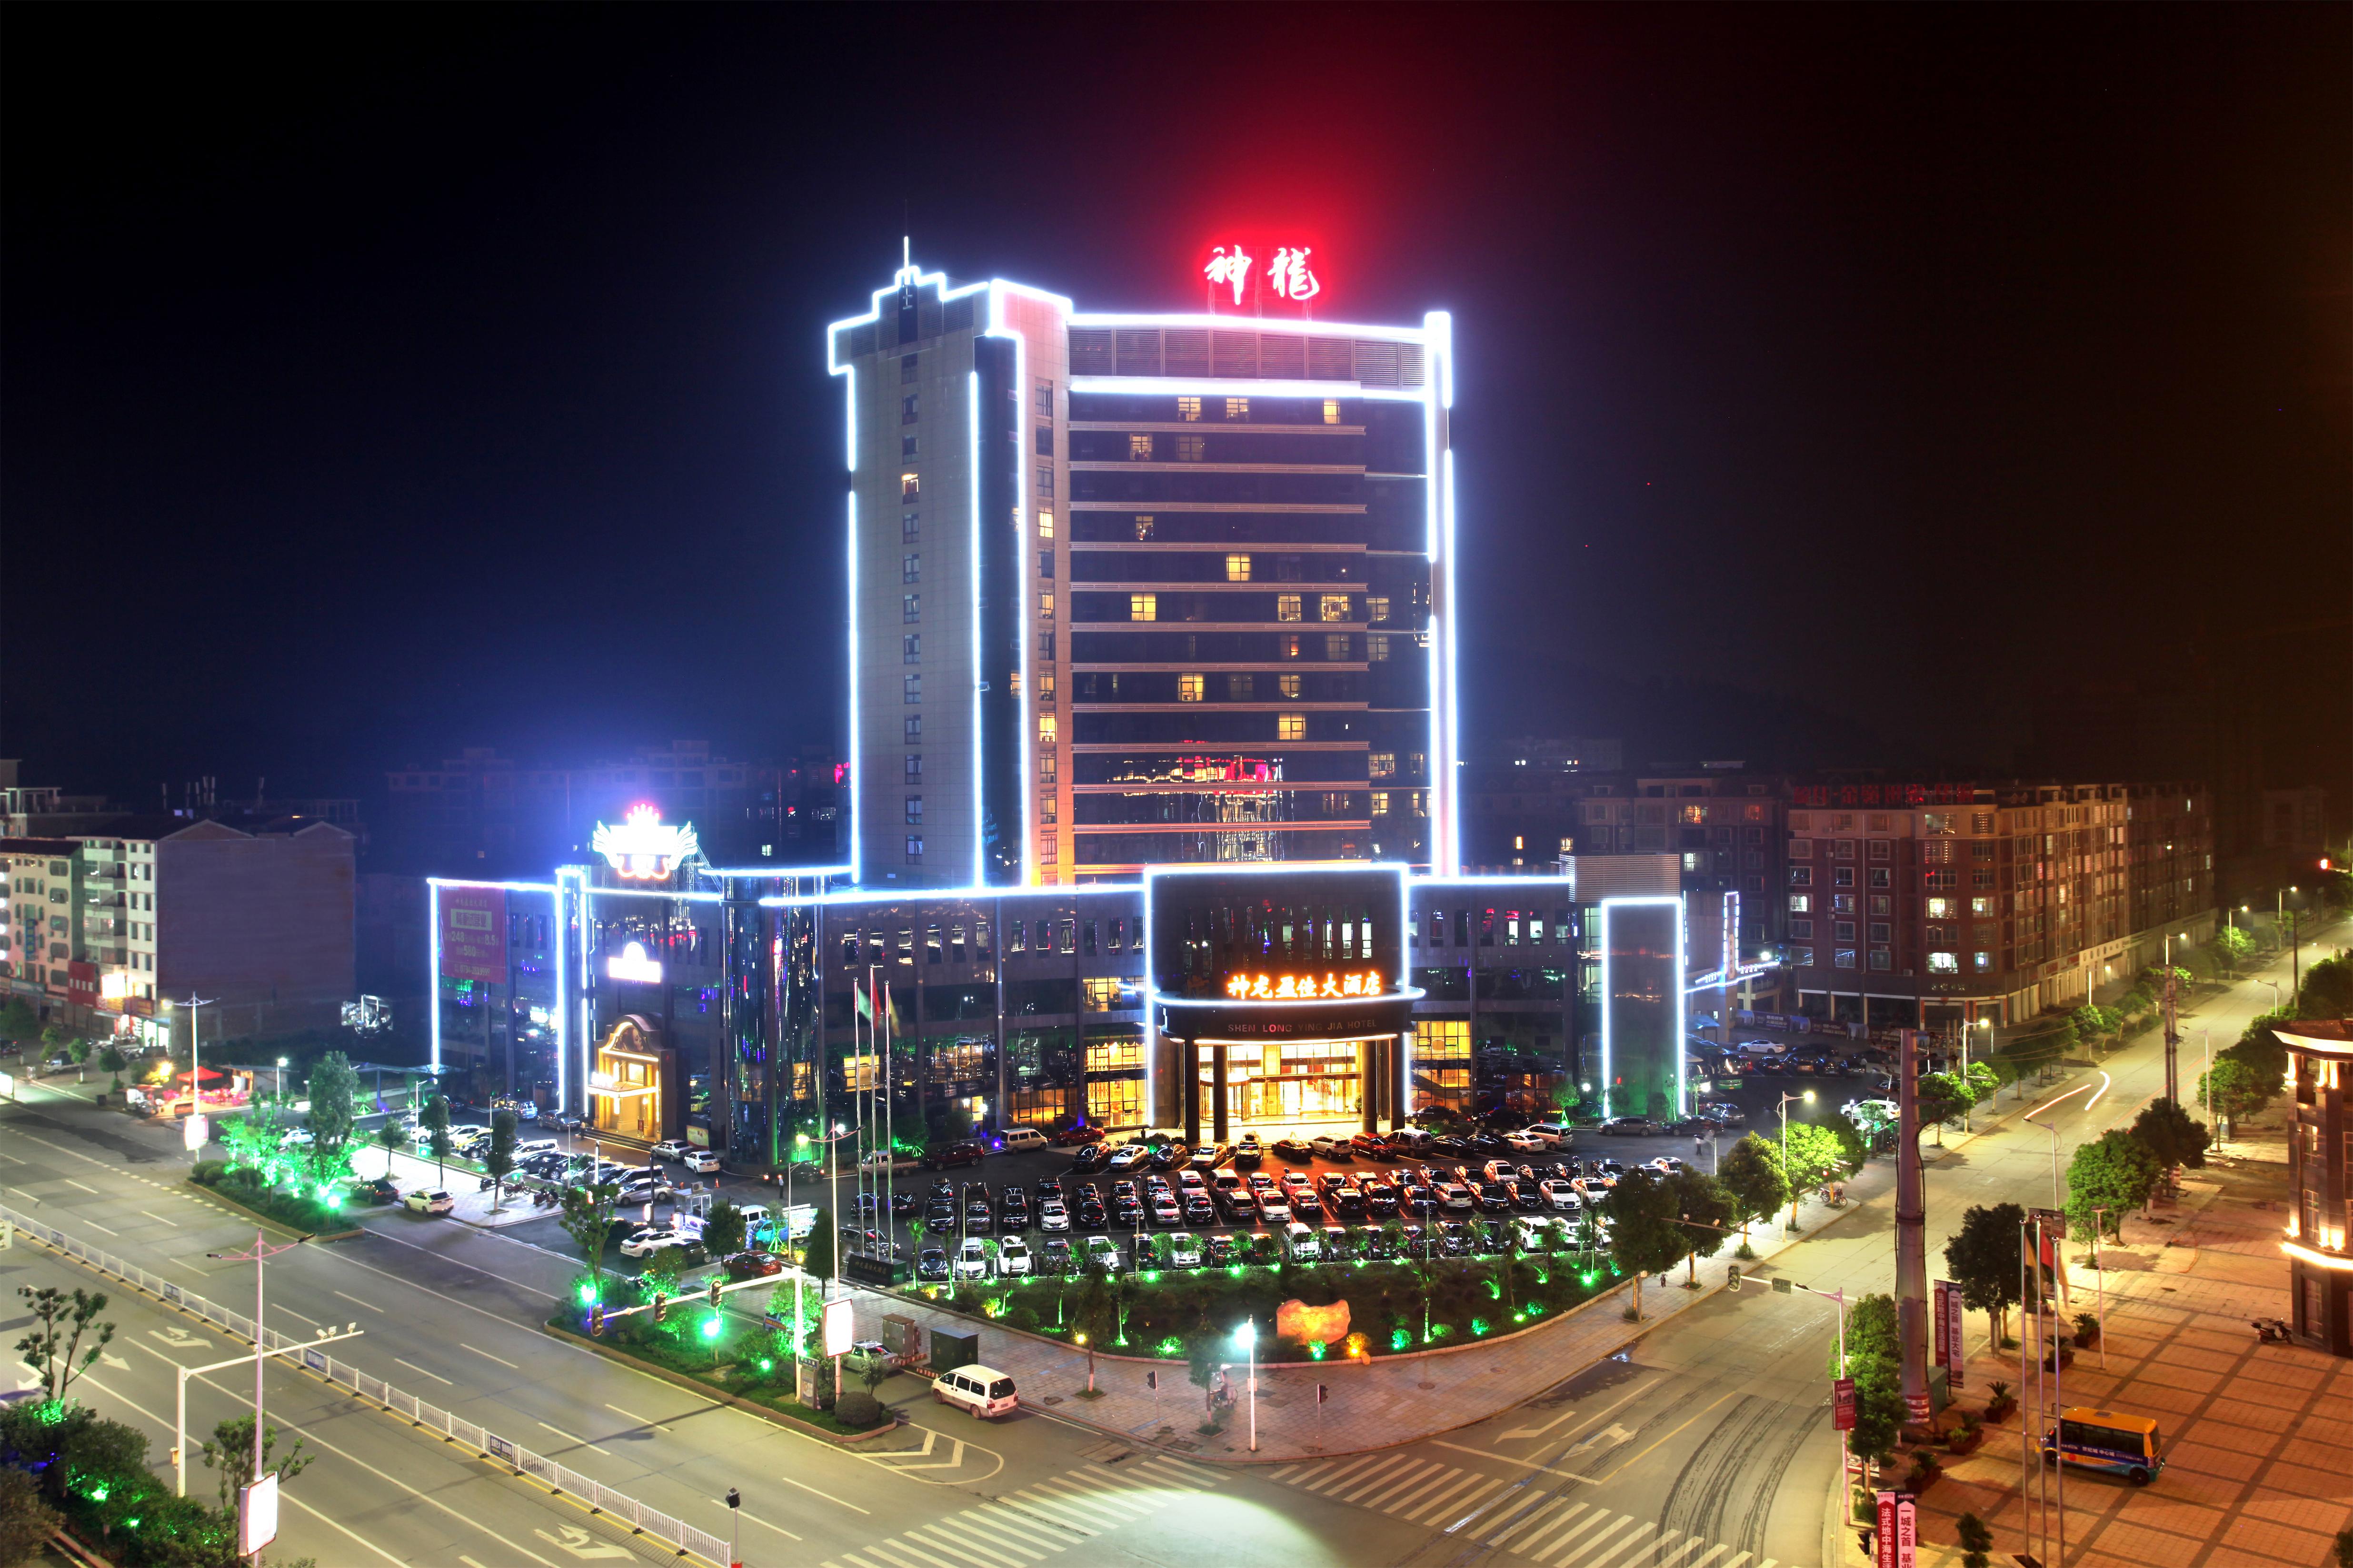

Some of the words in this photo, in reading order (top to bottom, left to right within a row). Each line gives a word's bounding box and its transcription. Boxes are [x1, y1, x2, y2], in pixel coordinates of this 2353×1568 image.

[1227, 970, 1381, 1000] 神龙盈佳大酒店
[1228, 1024, 1256, 1032] SHEN
[1263, 1024, 1292, 1032] LONG
[1298, 1023, 1323, 1032] YING
[1327, 1022, 1343, 1031] JIA
[1347, 1019, 1377, 1029] HOTEL
[1900, 1509, 1912, 1547] 一城之首
